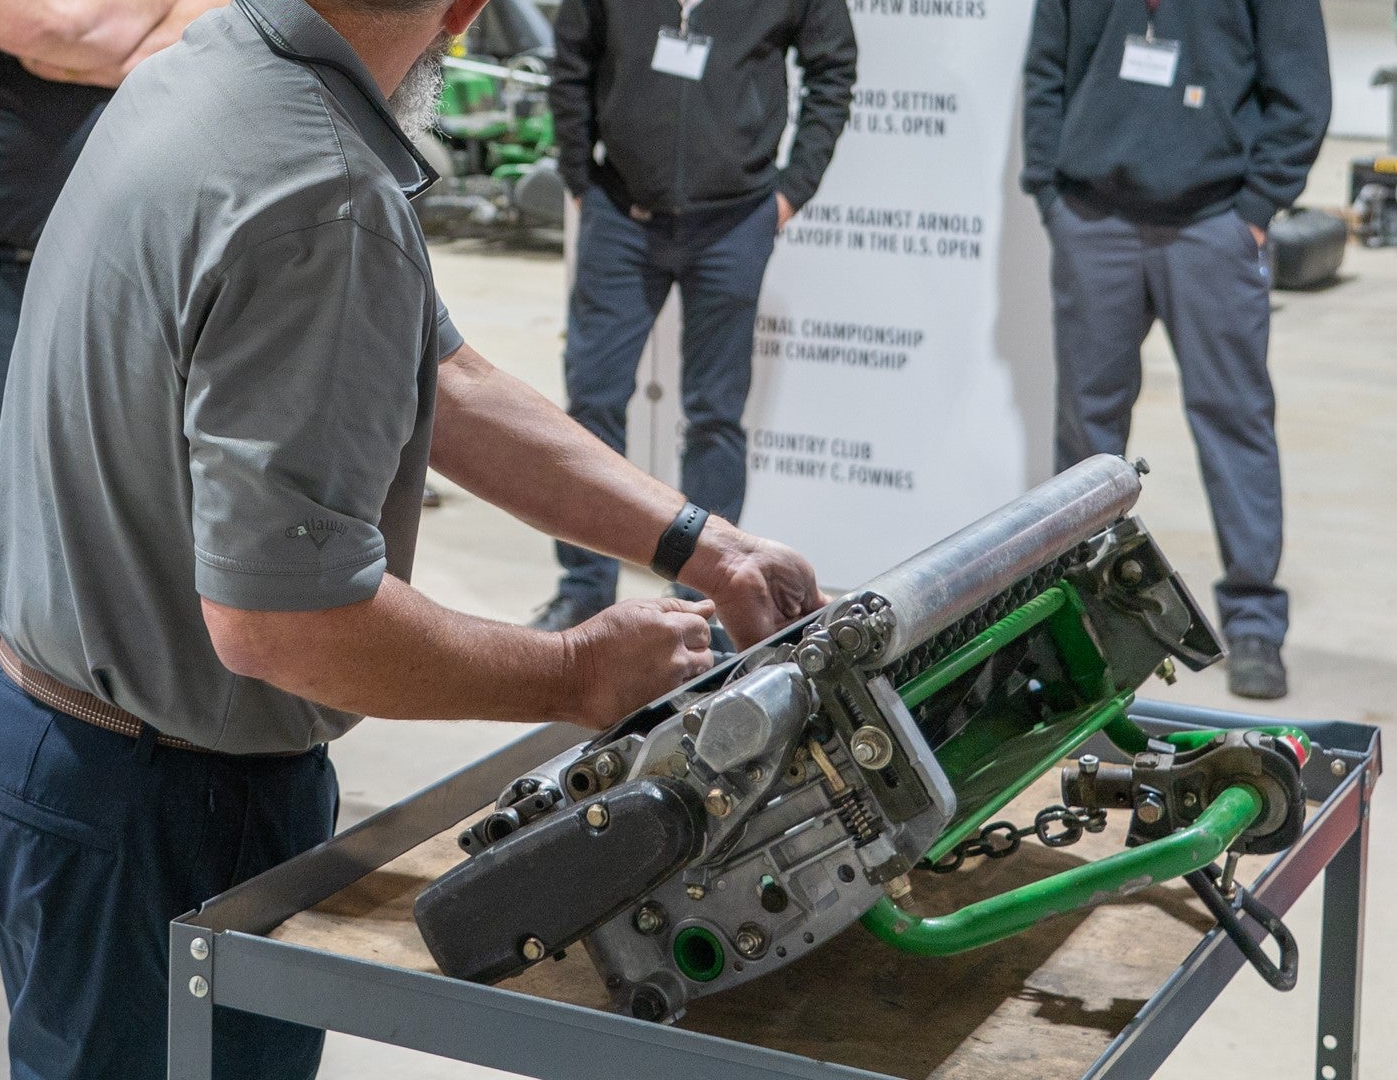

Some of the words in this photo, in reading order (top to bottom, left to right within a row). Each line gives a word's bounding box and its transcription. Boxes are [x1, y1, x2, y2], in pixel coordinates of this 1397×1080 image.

[892, 90, 956, 113] SETTING
[867, 113, 897, 134] U.S.
[902, 115, 945, 136] OPEN
[846, 205, 911, 228] AGAINST
[917, 211, 983, 235] ARNOLD
[847, 231, 863, 249] IN
[869, 231, 897, 252] THE
[903, 235, 933, 256] U.S.
[937, 238, 980, 259] OPEN
[801, 318, 924, 348] CHAMPIONSHIP
[785, 340, 907, 369] CHAMPIONSHIP
[754, 429, 825, 455] COUNTRY
[831, 438, 873, 461] CLUB
[775, 457, 825, 478] HENRY
[831, 463, 844, 483] C.
[848, 465, 914, 490] FOWNES
[284, 518, 348, 539] Callaway
